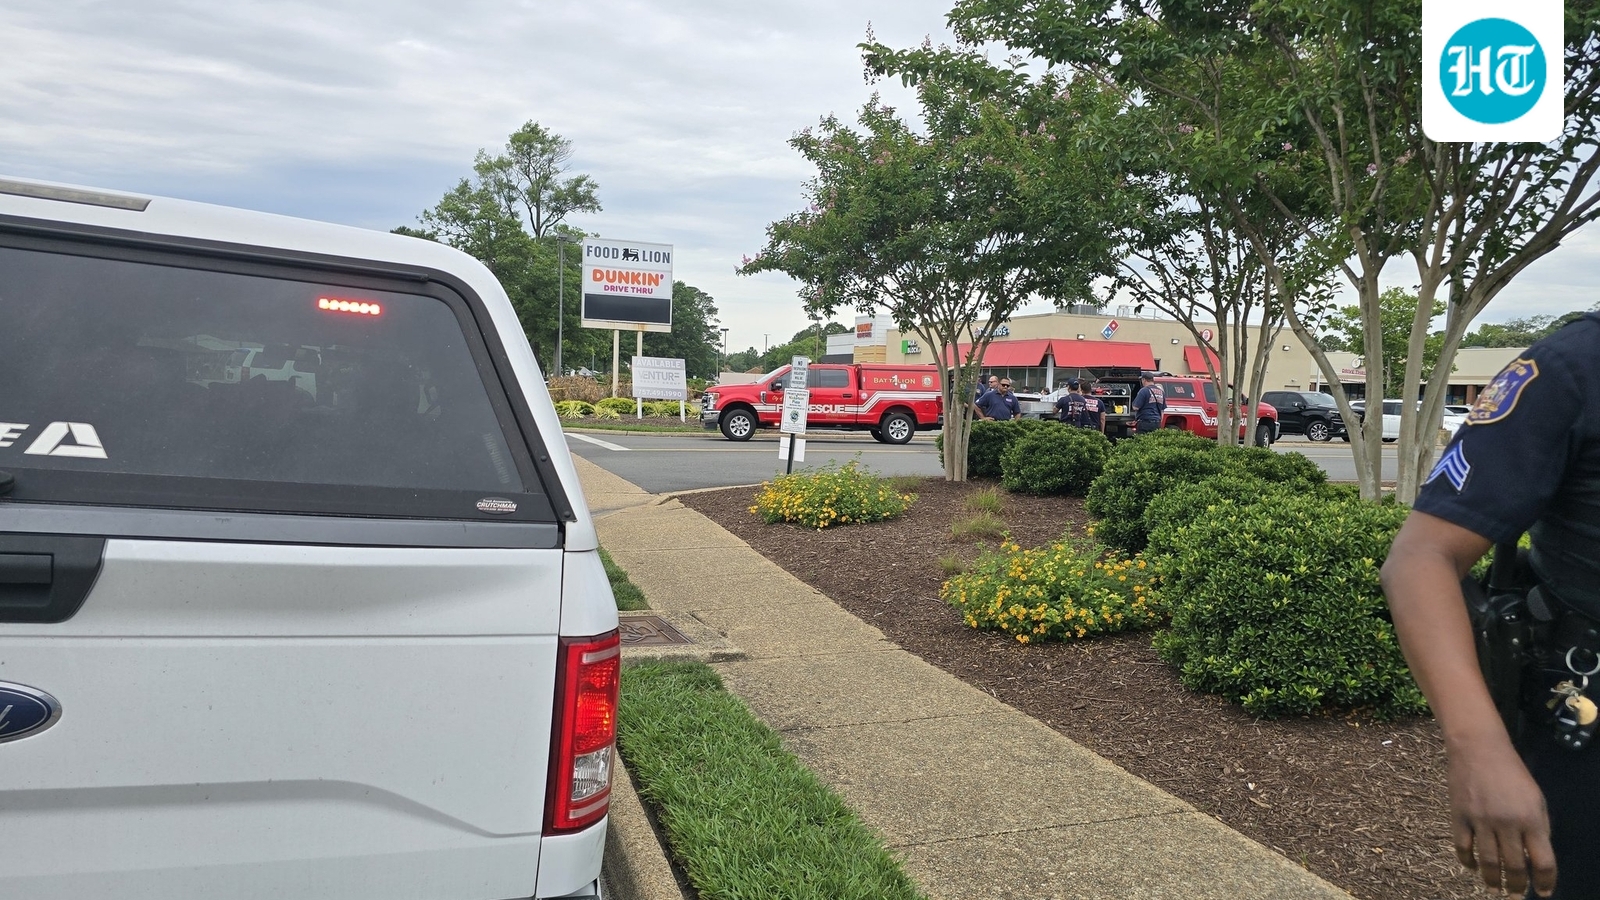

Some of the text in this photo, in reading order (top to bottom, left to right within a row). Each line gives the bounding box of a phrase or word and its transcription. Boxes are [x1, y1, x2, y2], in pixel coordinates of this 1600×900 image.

[586, 245, 671, 264] FOOD LION
[592, 268, 665, 287] DUNKIN'
[603, 284, 653, 295] DRIVE THRU
[636, 359, 681, 369] AVAILABLE
[638, 370, 680, 382] VENTURE
[873, 377, 916, 385] BATTALION
[476, 501, 518, 509] CRUTCHMAN
